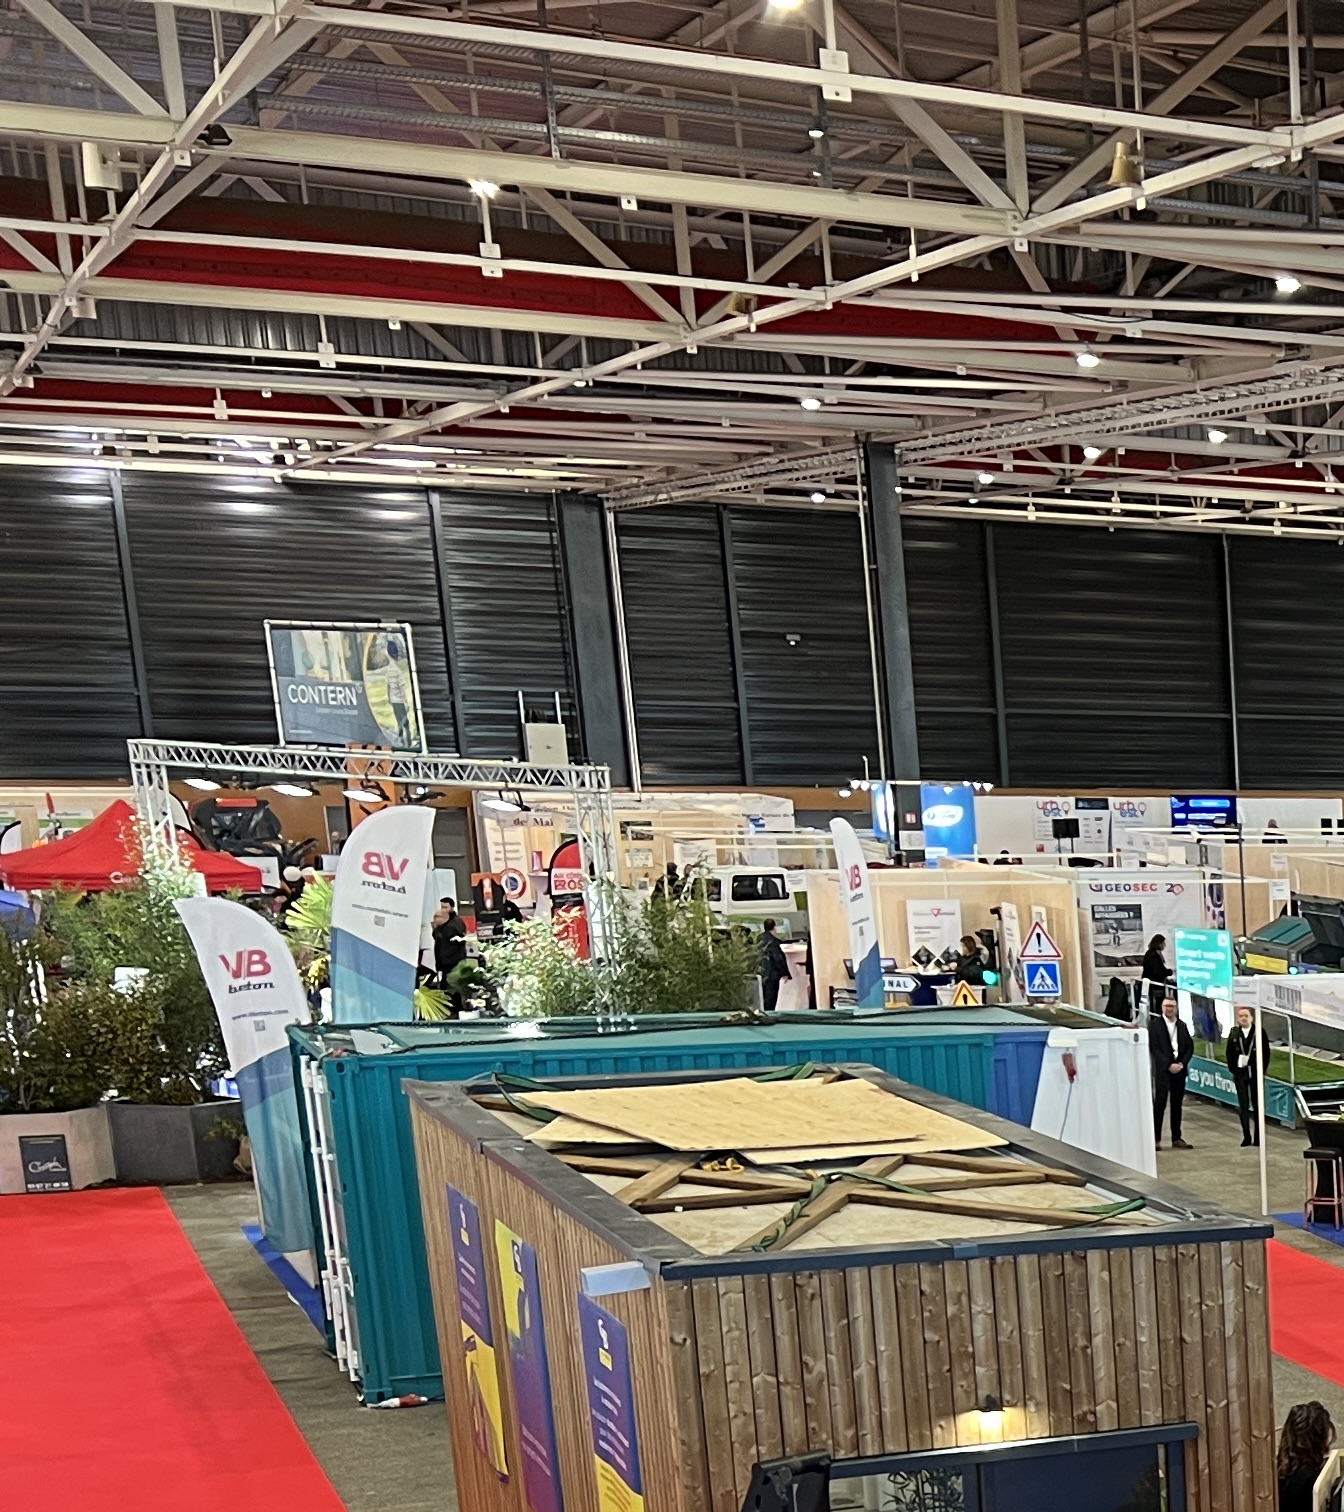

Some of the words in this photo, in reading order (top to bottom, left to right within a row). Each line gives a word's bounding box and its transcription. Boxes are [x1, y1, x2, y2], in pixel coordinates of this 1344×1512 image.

[287, 684, 358, 706] CONTERN
[1104, 883, 1158, 892] GEOSEC
[217, 949, 272, 979] VB
